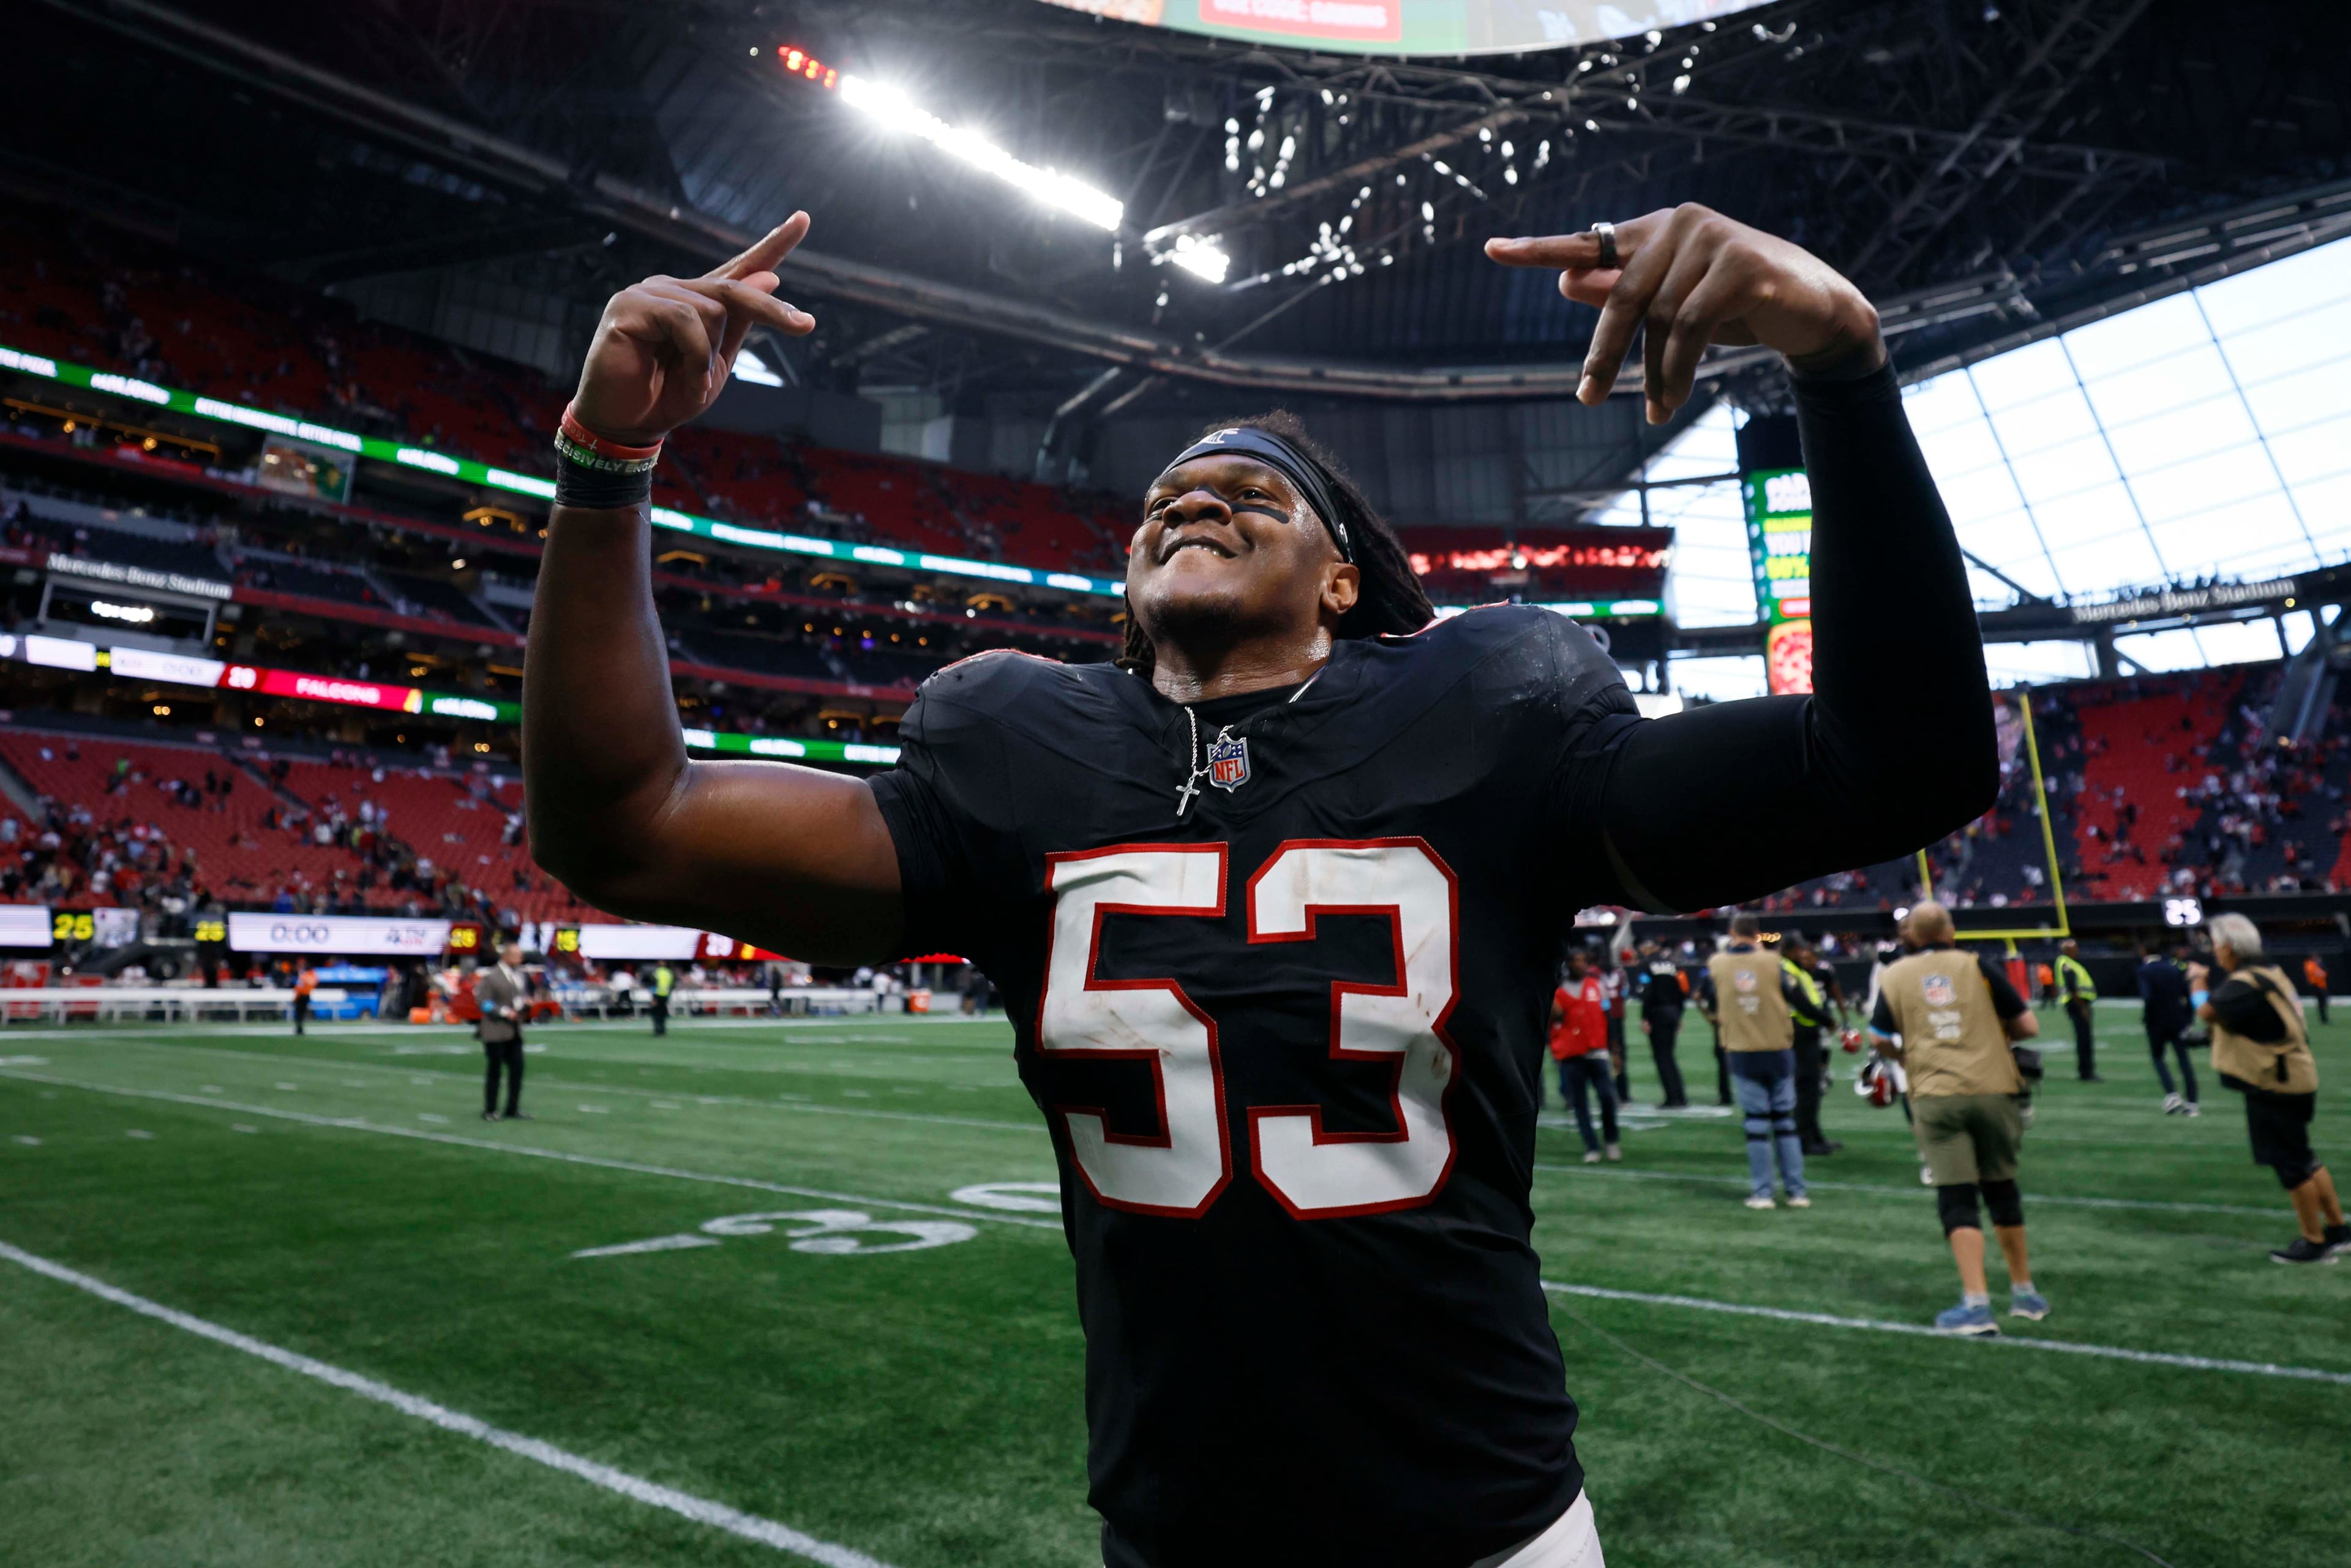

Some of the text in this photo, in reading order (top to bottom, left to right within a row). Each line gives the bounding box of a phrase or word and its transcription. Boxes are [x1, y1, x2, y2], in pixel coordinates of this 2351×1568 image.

[47, 552, 169, 590] Mercedes-Benz
[168, 572, 233, 600] Stadium
[2210, 580, 2295, 603] Stadium
[296, 677, 381, 704] FALCONS
[1214, 759, 1243, 782] NFL
[53, 913, 94, 940] 25
[270, 923, 329, 943] 0:00
[1035, 835, 1460, 1221] 53
